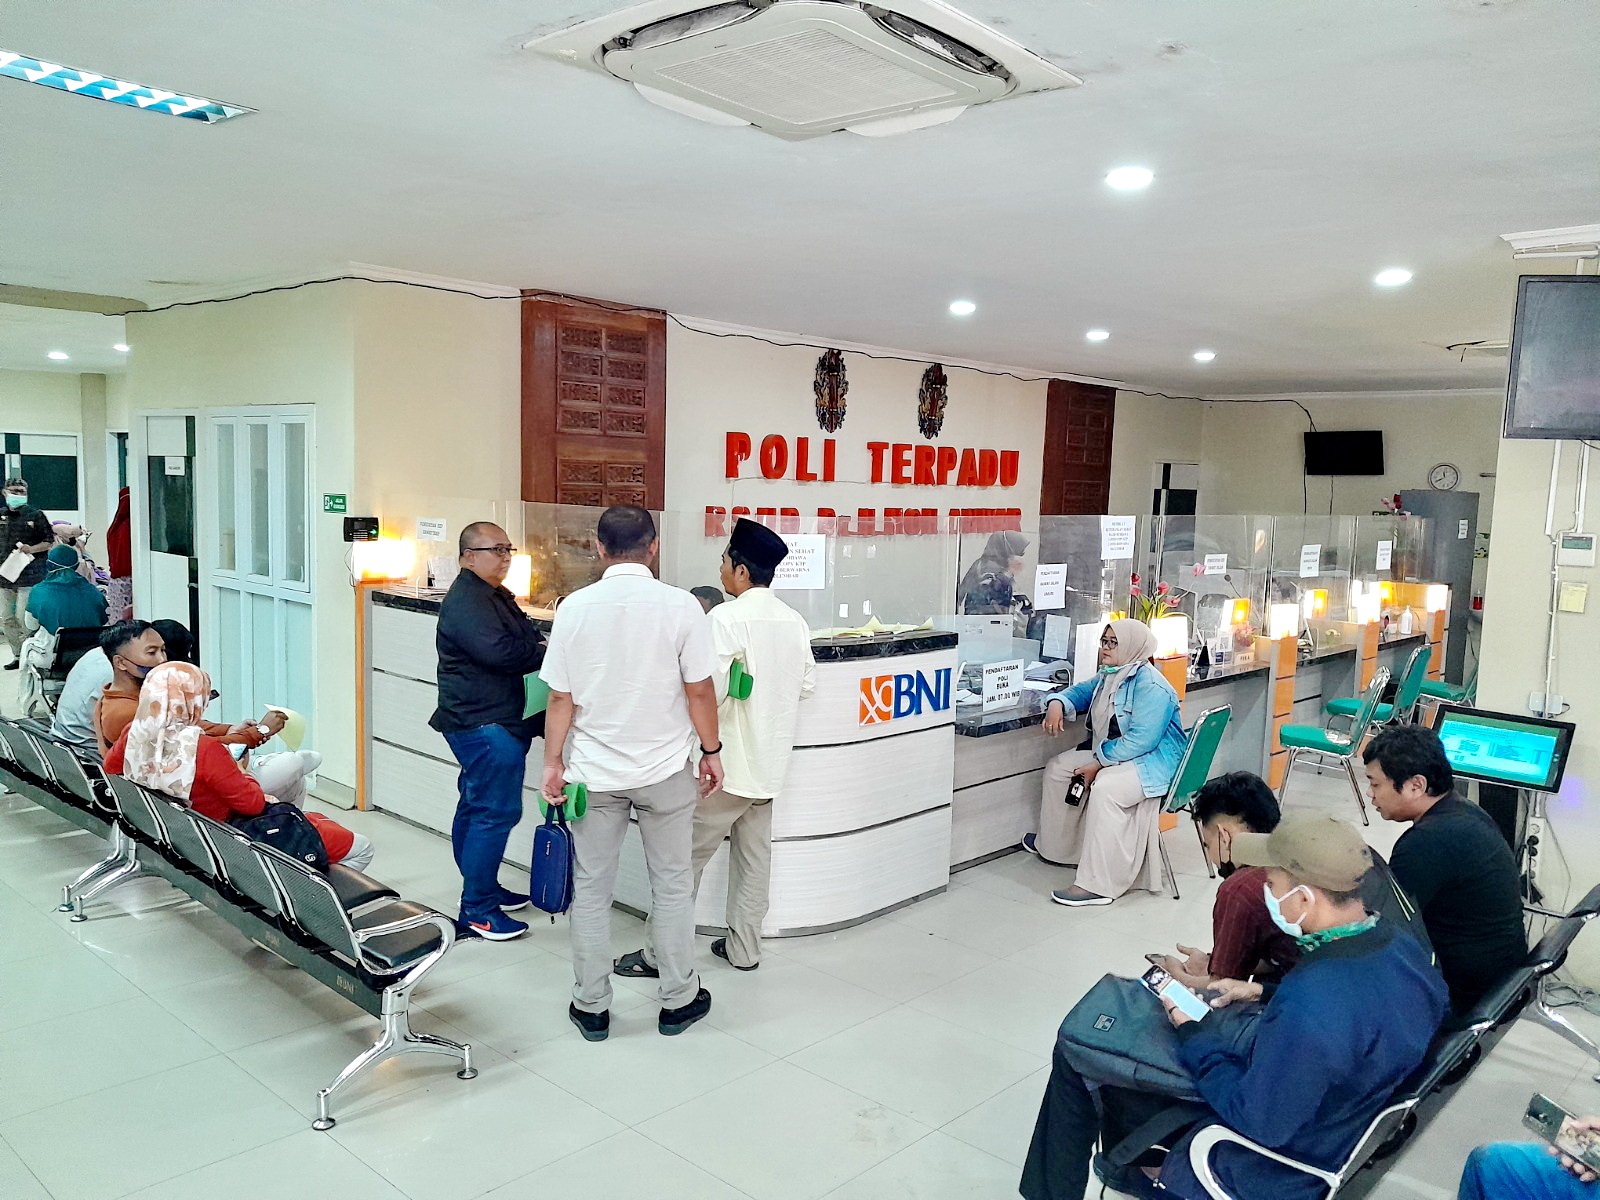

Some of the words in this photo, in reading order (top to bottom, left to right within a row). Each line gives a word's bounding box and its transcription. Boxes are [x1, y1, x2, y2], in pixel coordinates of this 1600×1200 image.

[725, 431, 836, 482] POLI
[867, 441, 1020, 487] TERPADU
[985, 664, 1019, 675] PENDAFTARAN
[893, 667, 953, 719] BNI
[996, 682, 1009, 690] BUKA
